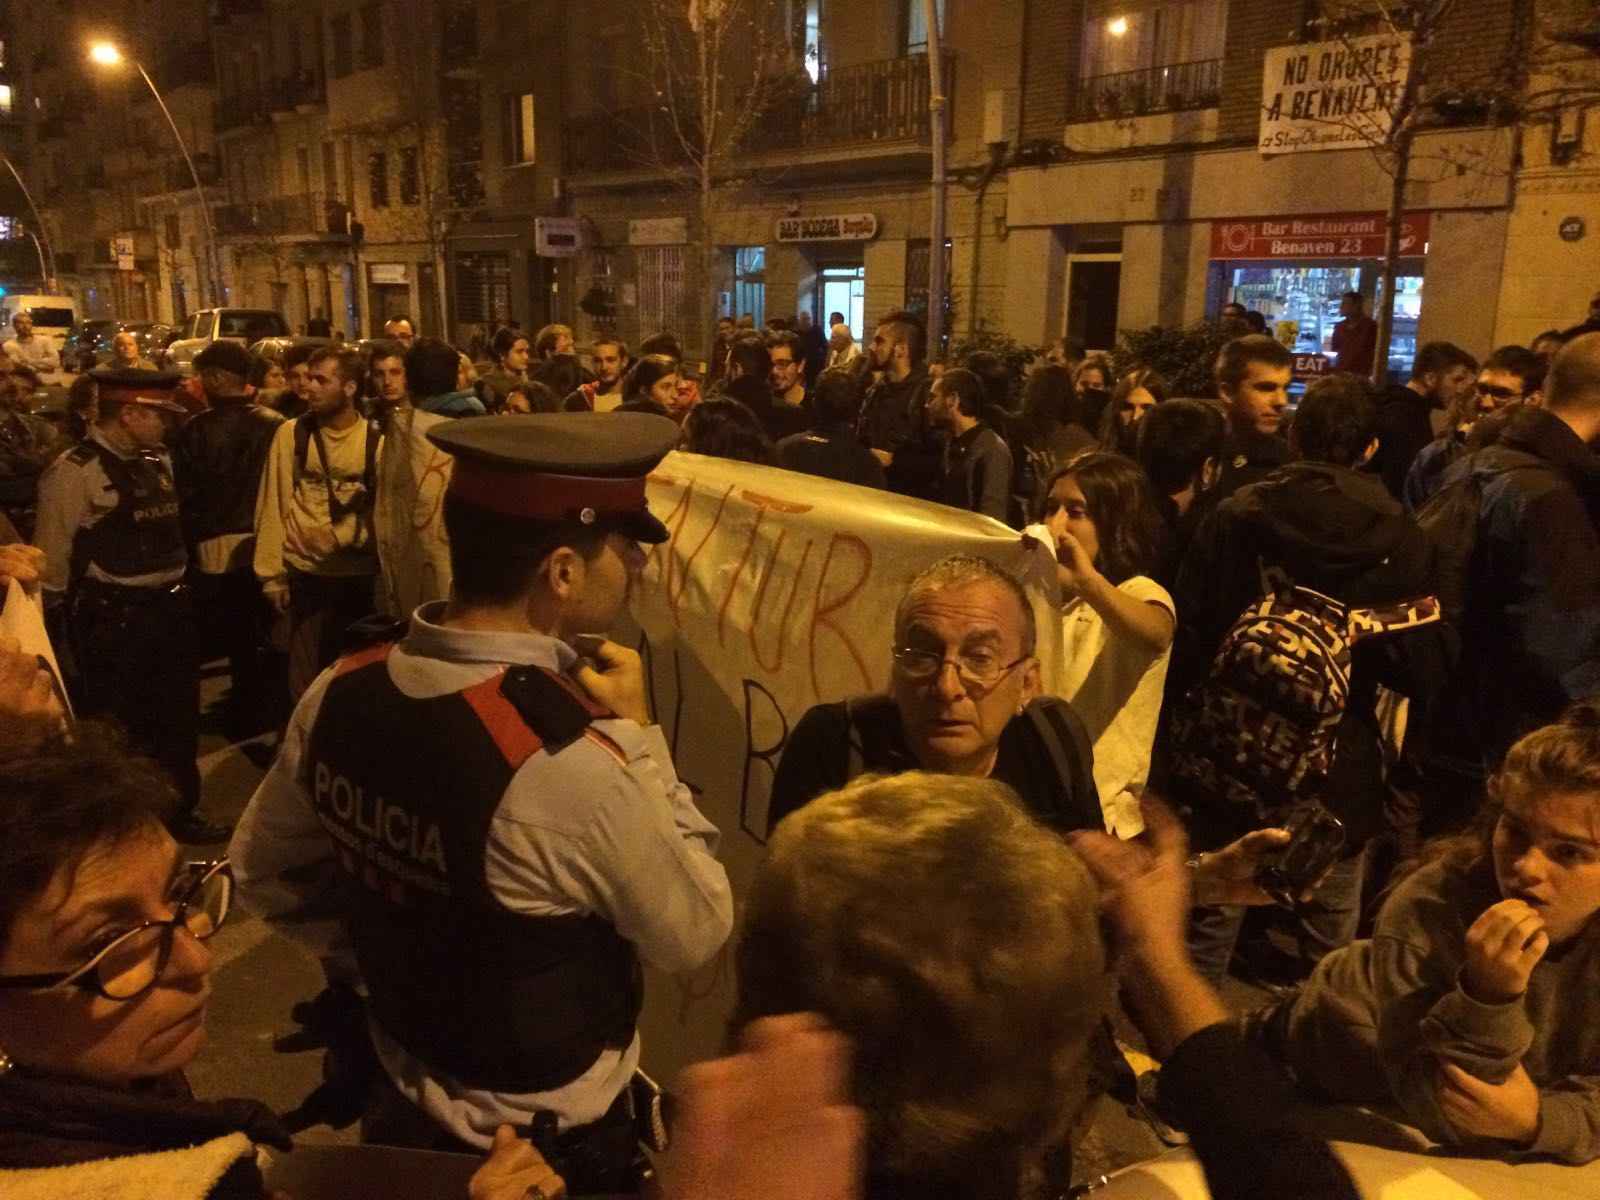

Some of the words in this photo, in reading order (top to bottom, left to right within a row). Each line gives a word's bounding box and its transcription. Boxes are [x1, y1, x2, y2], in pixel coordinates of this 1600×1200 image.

[1284, 55, 1309, 85] NO
[1267, 92, 1282, 121] A
[1261, 222, 1288, 236] Bar
[1292, 219, 1376, 235] Restaurant
[1271, 240, 1335, 254] Benaven
[1340, 239, 1362, 253] 23
[1296, 357, 1326, 370] EAT
[314, 760, 449, 872] POLICIA
